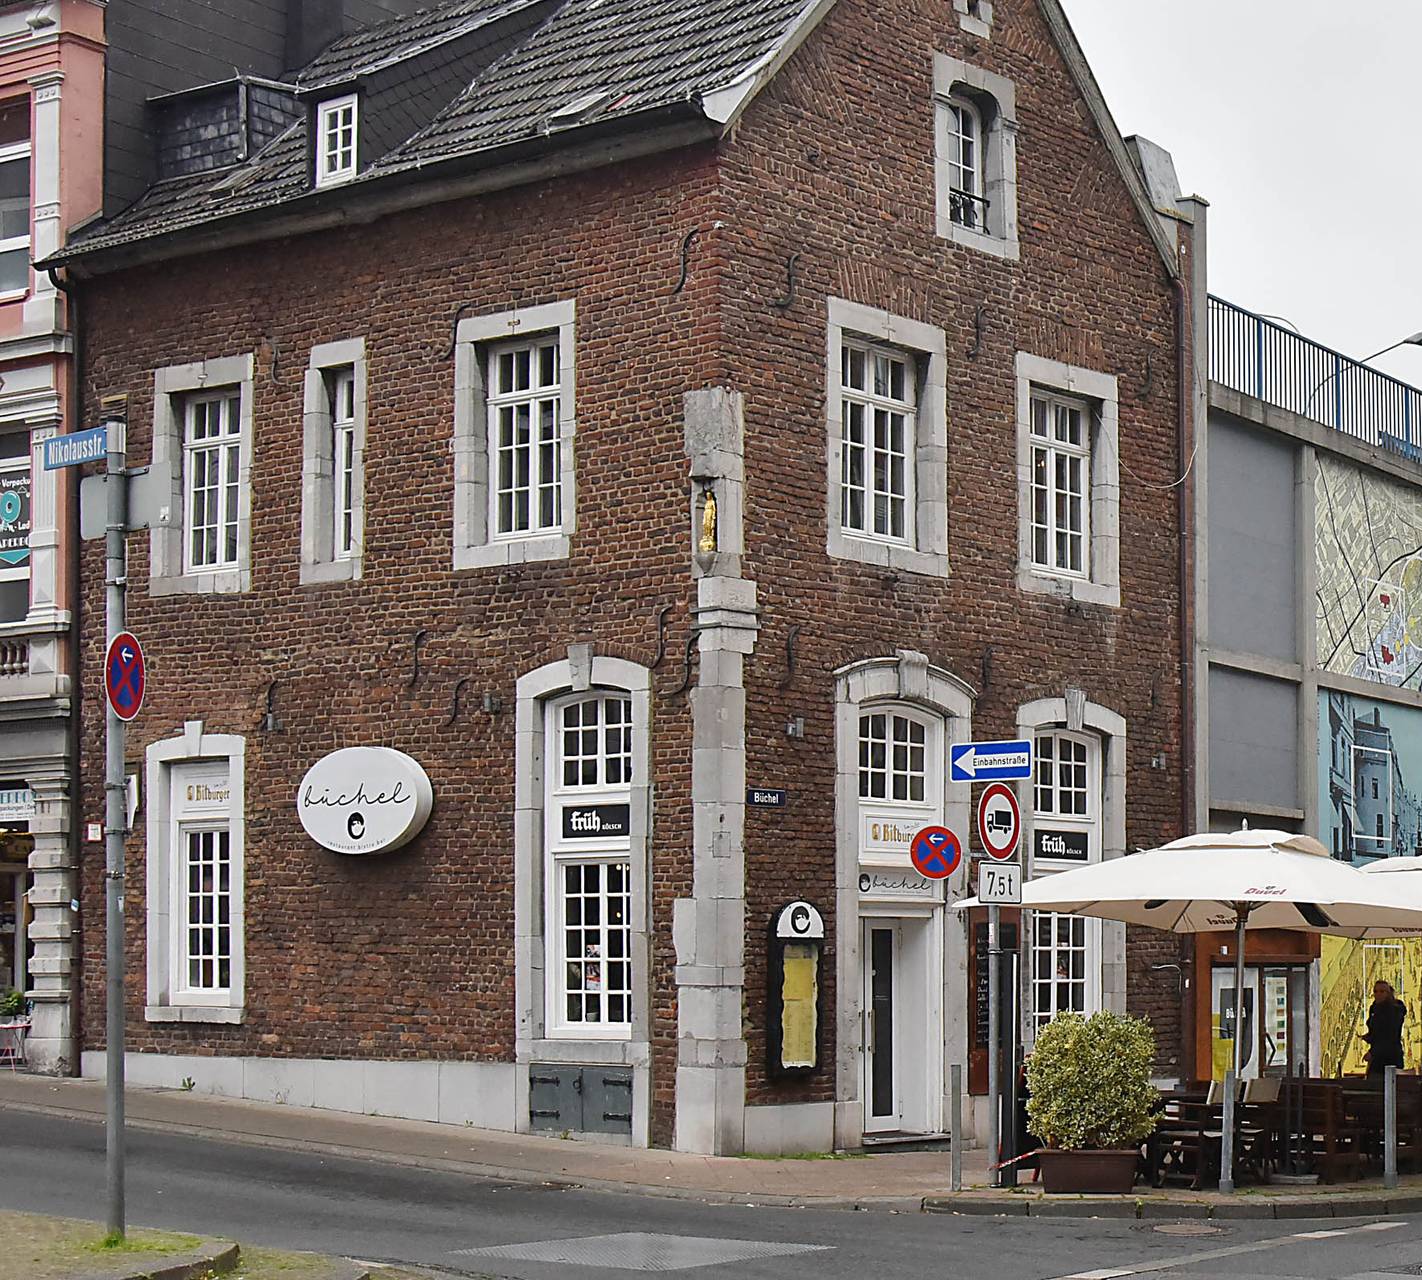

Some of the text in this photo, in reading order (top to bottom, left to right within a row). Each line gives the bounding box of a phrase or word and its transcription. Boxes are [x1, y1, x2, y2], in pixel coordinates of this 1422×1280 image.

[48, 434, 105, 465] Nikolausstr.
[972, 756, 1026, 767] Einbahnstraße
[304, 781, 411, 808] büchel
[753, 791, 779, 804] Büchel
[882, 823, 915, 843] Bitbur
